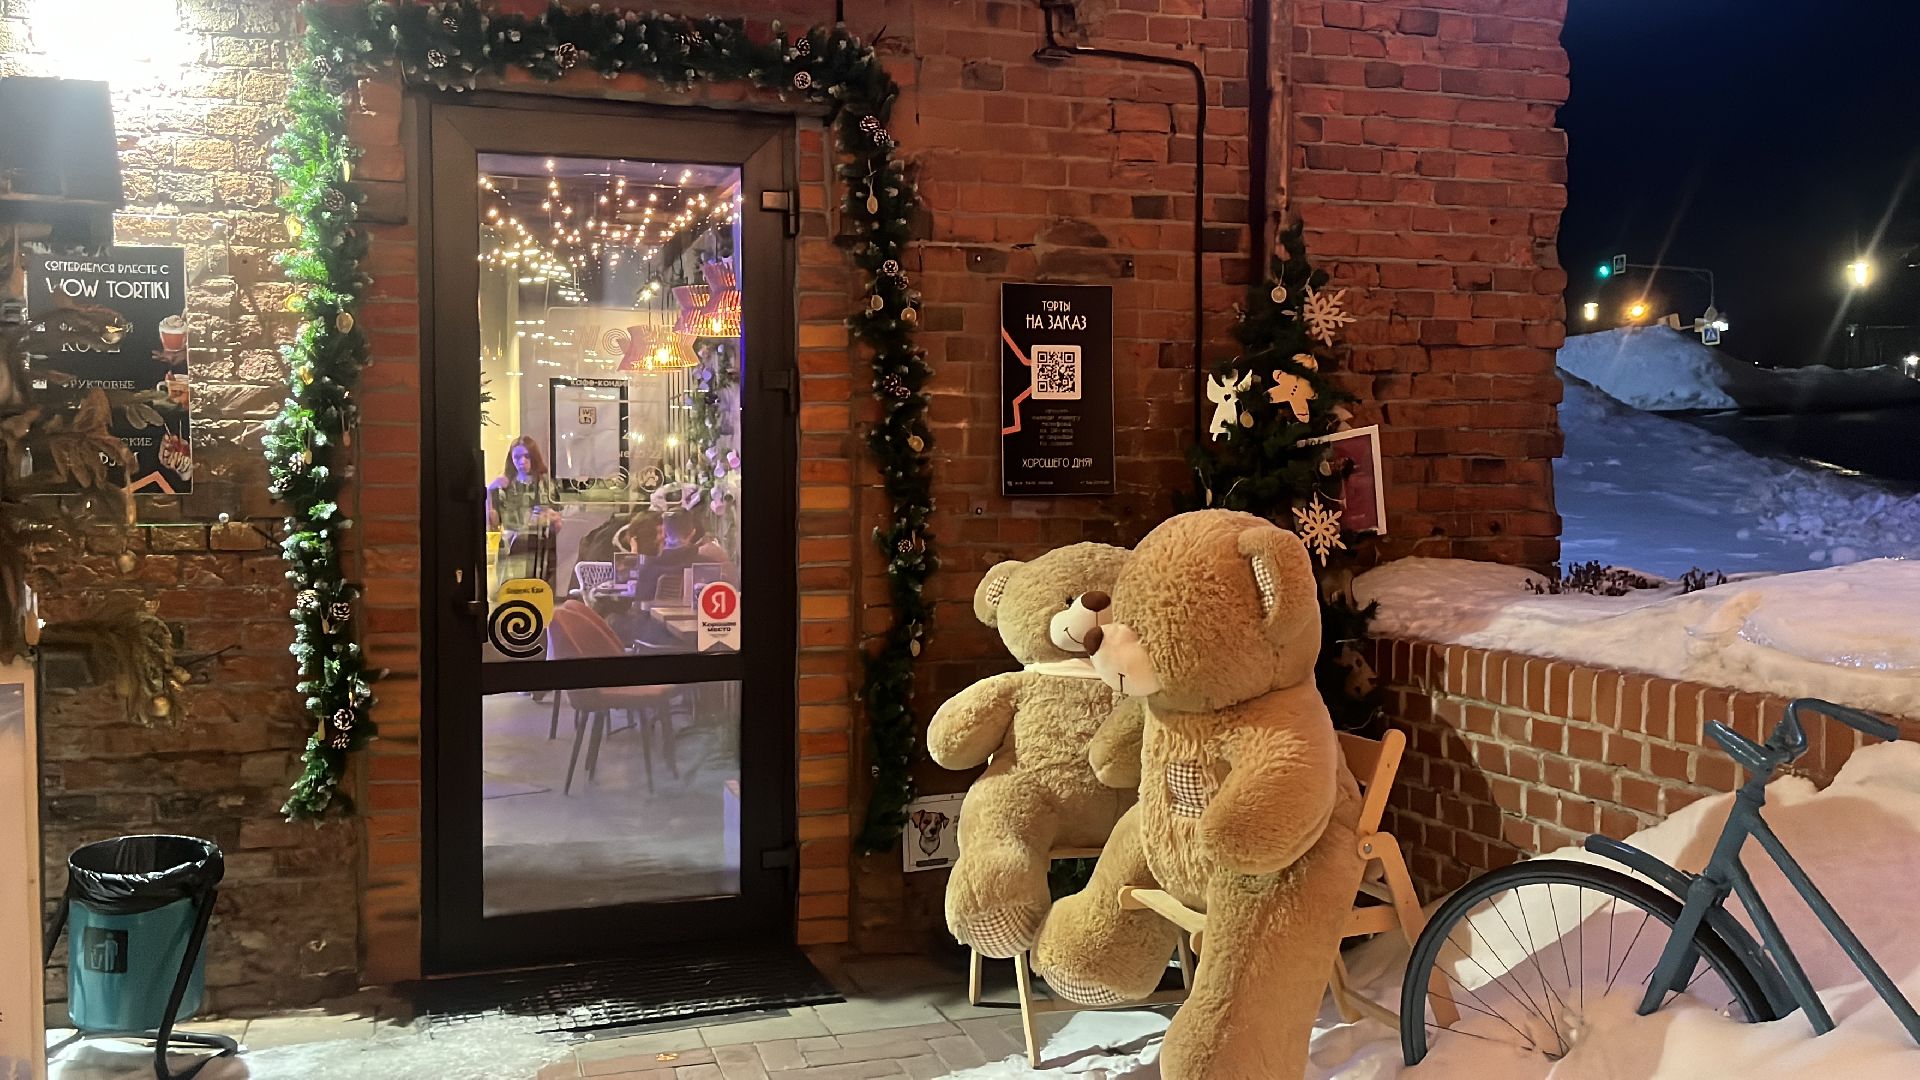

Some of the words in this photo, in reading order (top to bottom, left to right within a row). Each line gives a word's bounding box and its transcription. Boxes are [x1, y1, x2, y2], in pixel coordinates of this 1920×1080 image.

[106, 280, 170, 299] TORTIKI
[1041, 300, 1071, 312] ТОРТЫ
[1026, 313, 1044, 329] НА
[1047, 314, 1087, 330] ЗАКАЗ
[62, 379, 135, 389] РУКТОВЫЕ
[1022, 457, 1070, 468] ХОРОШЕГО
[711, 591, 726, 614] Я
